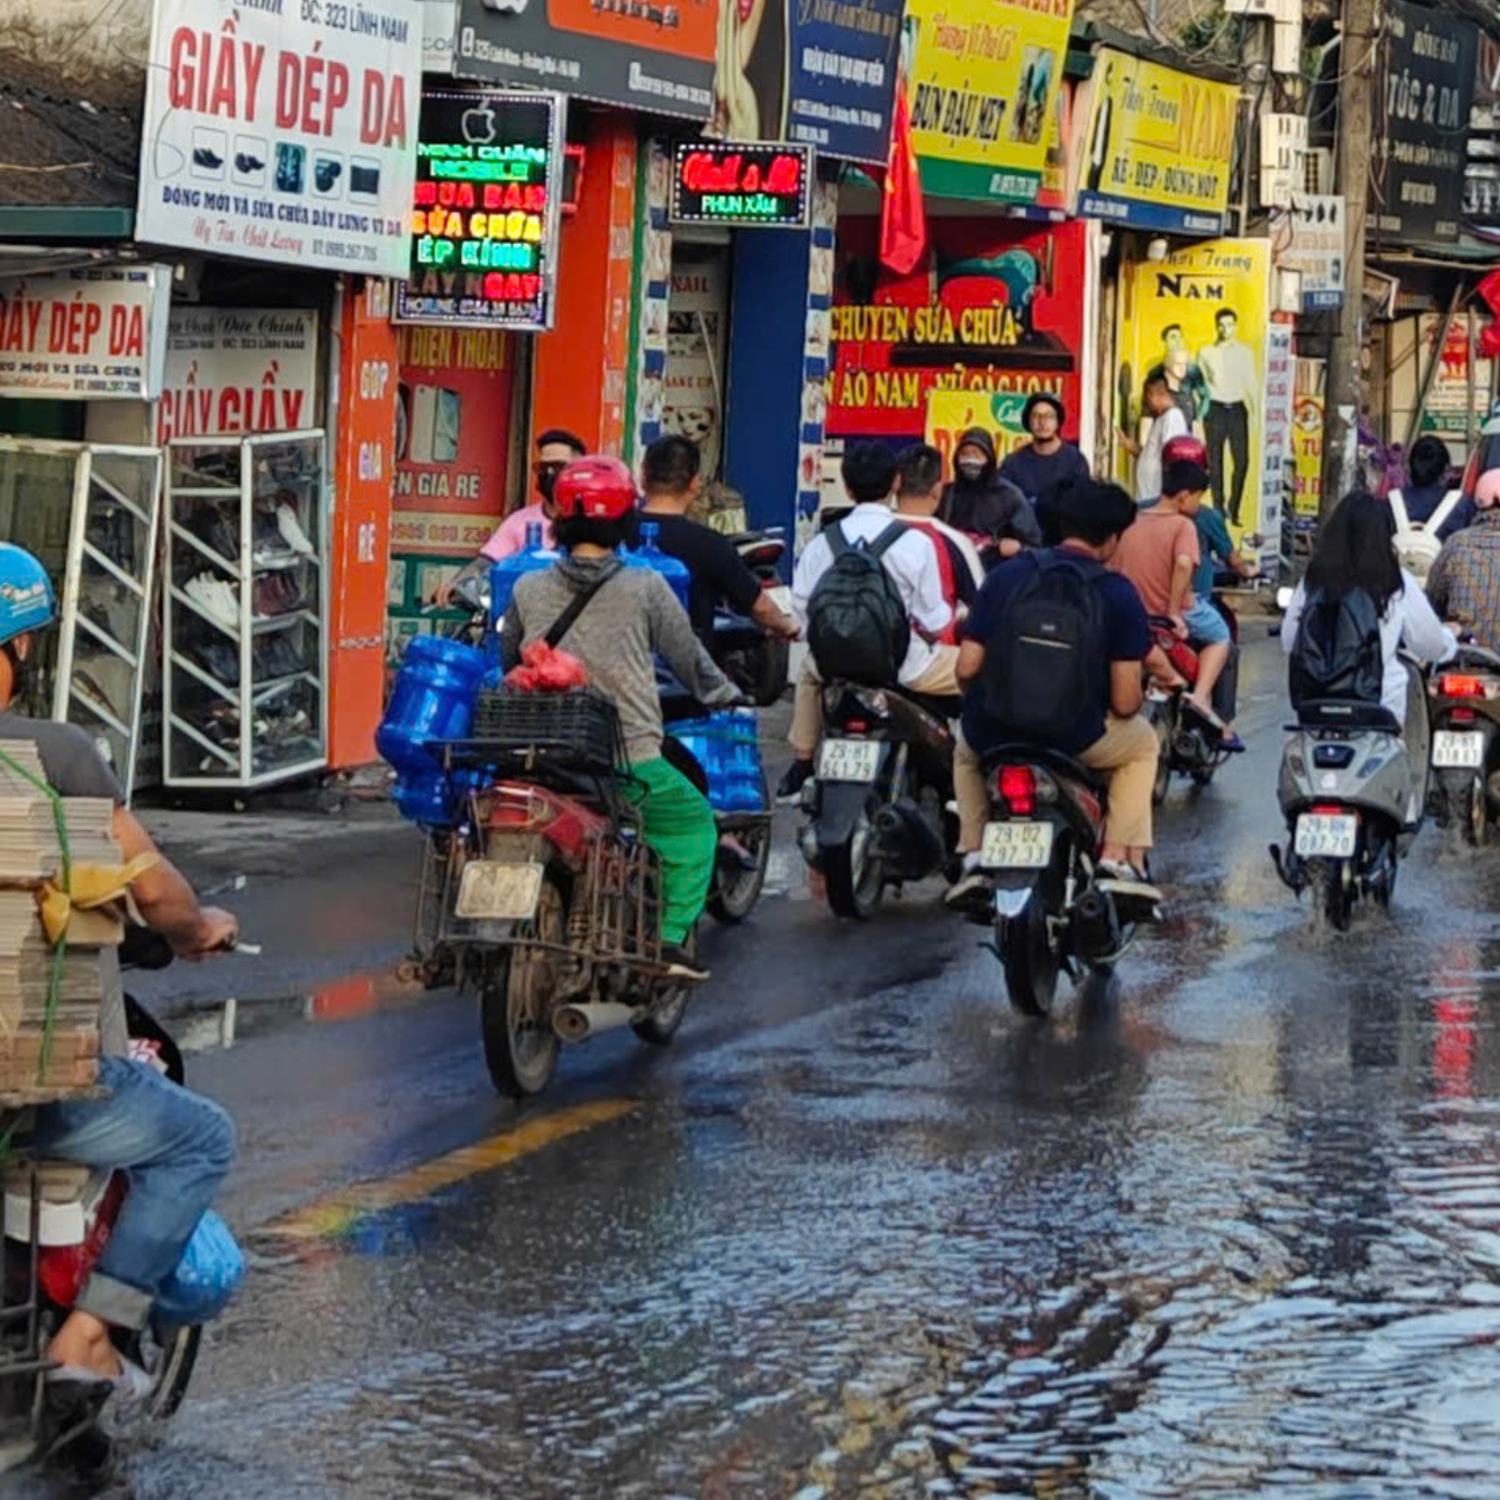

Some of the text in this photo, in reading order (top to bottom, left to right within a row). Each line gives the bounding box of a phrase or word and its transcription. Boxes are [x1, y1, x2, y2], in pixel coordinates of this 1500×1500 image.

[324, 1, 347, 30] 323
[380, 16, 408, 44] NAM
[168, 10, 407, 151] GIẦY DÉP DA
[0, 279, 43, 353] IẦY
[48, 289, 102, 355] DÉP
[108, 303, 144, 357] DA
[874, 371, 920, 409] NAM
